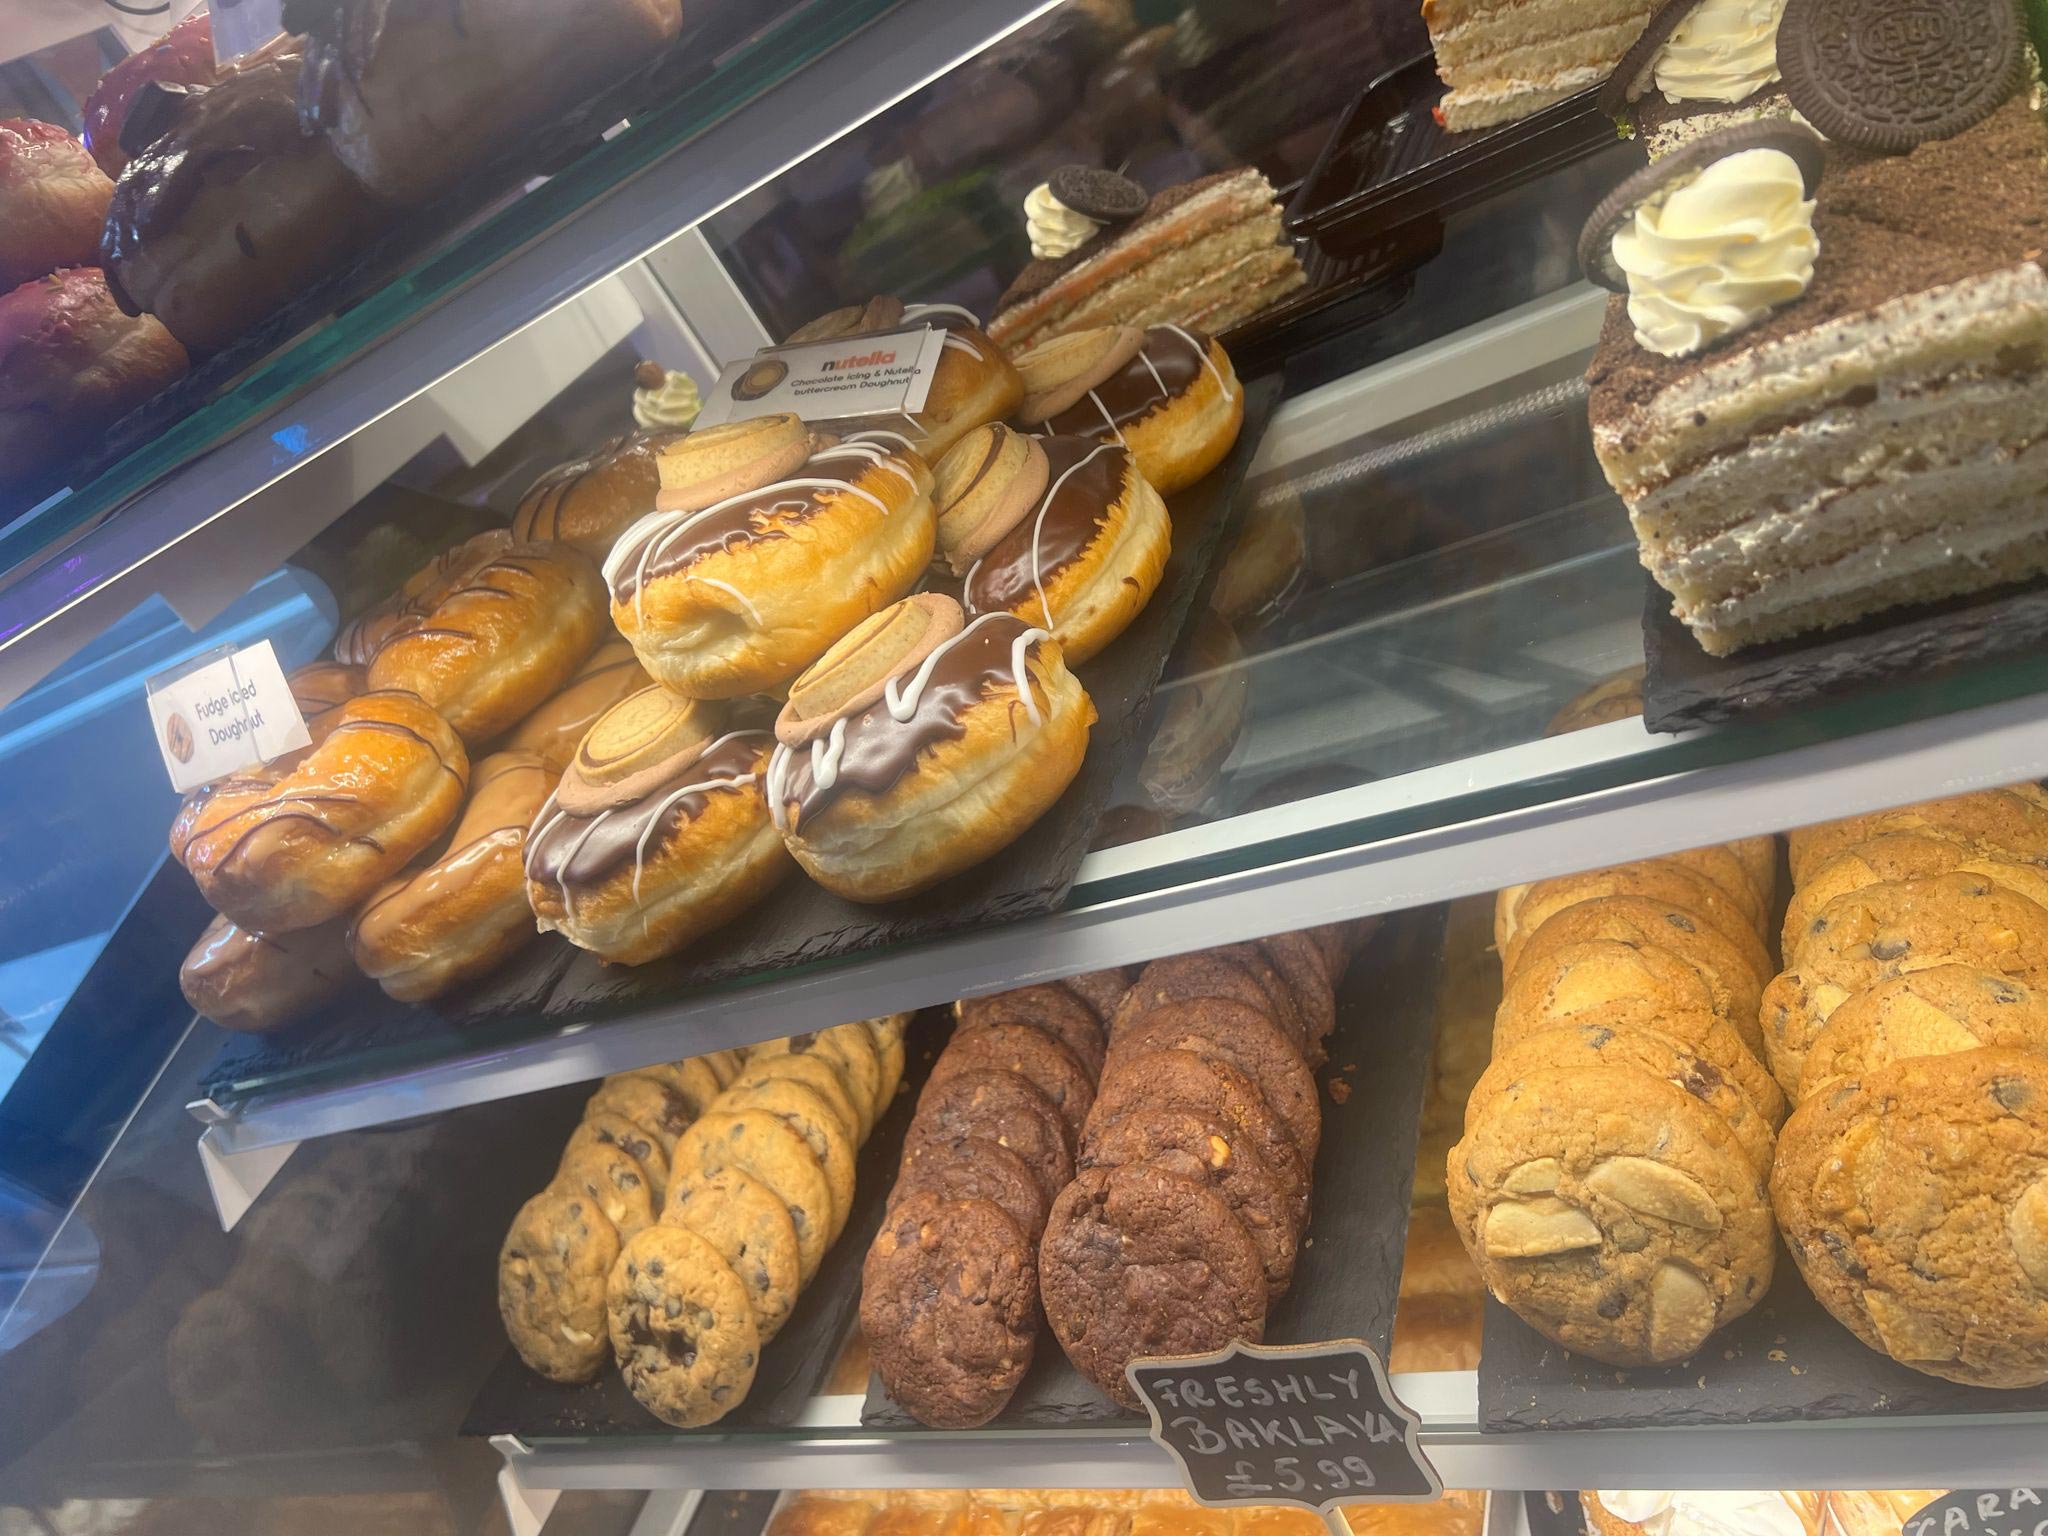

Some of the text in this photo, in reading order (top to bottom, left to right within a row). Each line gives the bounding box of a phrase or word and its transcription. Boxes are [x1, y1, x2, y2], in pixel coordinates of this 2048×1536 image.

[791, 375, 844, 387] Chocolate
[873, 369, 882, 377] &
[883, 366, 922, 377] Nutella
[821, 350, 896, 372] nutella
[793, 377, 910, 396] buttercream Doughnut
[194, 695, 229, 721] Fudge
[208, 709, 265, 746] Doughnut
[1152, 1368, 1360, 1408] FRESHLY
[1169, 1410, 1404, 1455] BAKLAVA
[1224, 1455, 1377, 1497] £5.99
